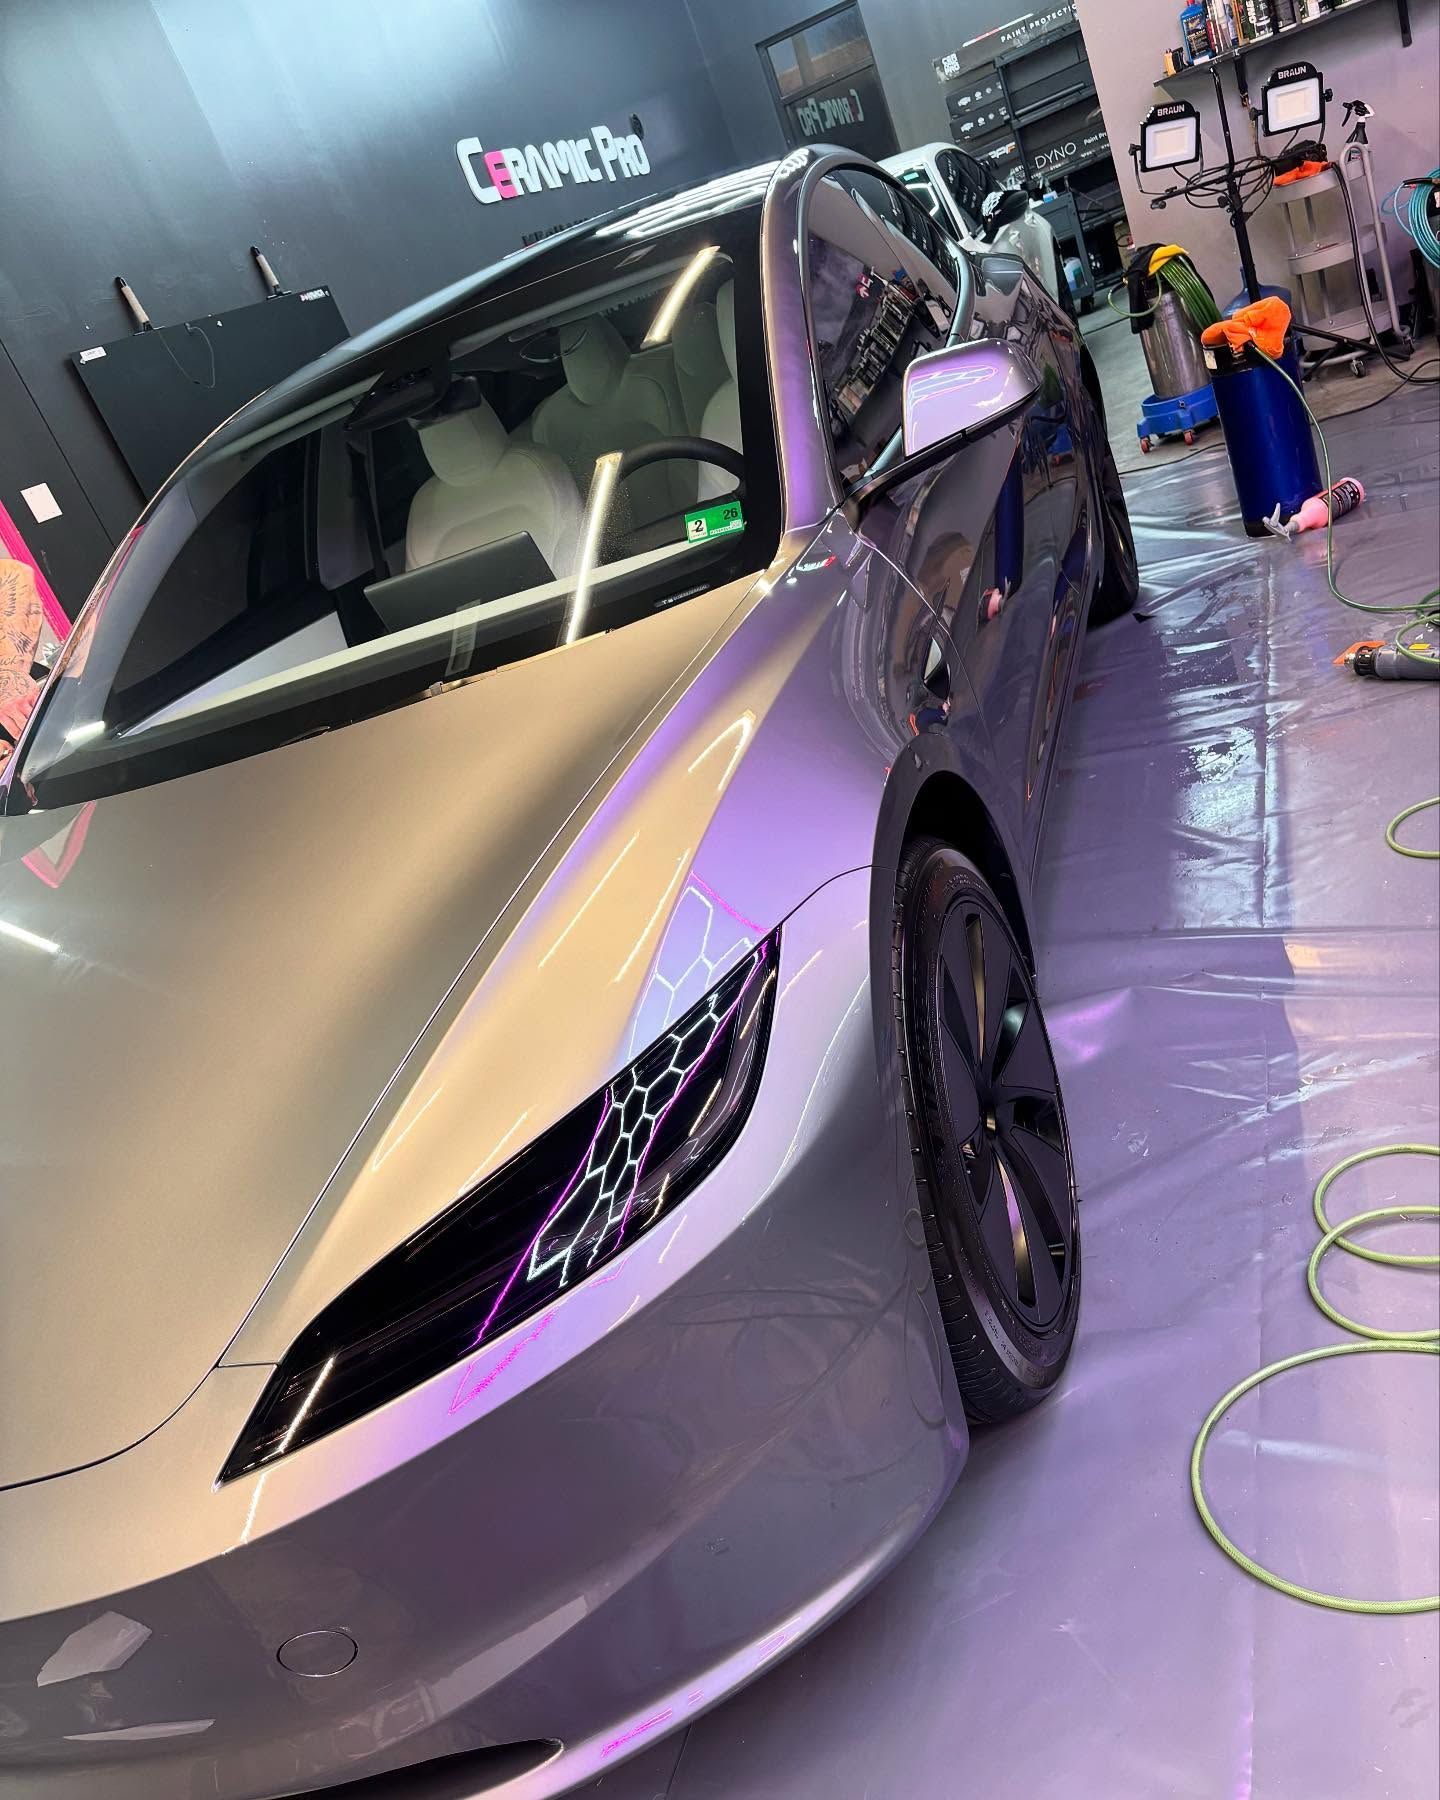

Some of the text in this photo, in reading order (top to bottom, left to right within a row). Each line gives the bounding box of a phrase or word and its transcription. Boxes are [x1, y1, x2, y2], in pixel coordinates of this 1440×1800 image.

[1000, 26, 1026, 43] PAINT
[1277, 65, 1307, 80] BRAUN
[1157, 104, 1185, 117] BRAUN
[1034, 142, 1077, 169] DYNO
[723, 507, 738, 520] 26
[694, 519, 704, 533] 2
